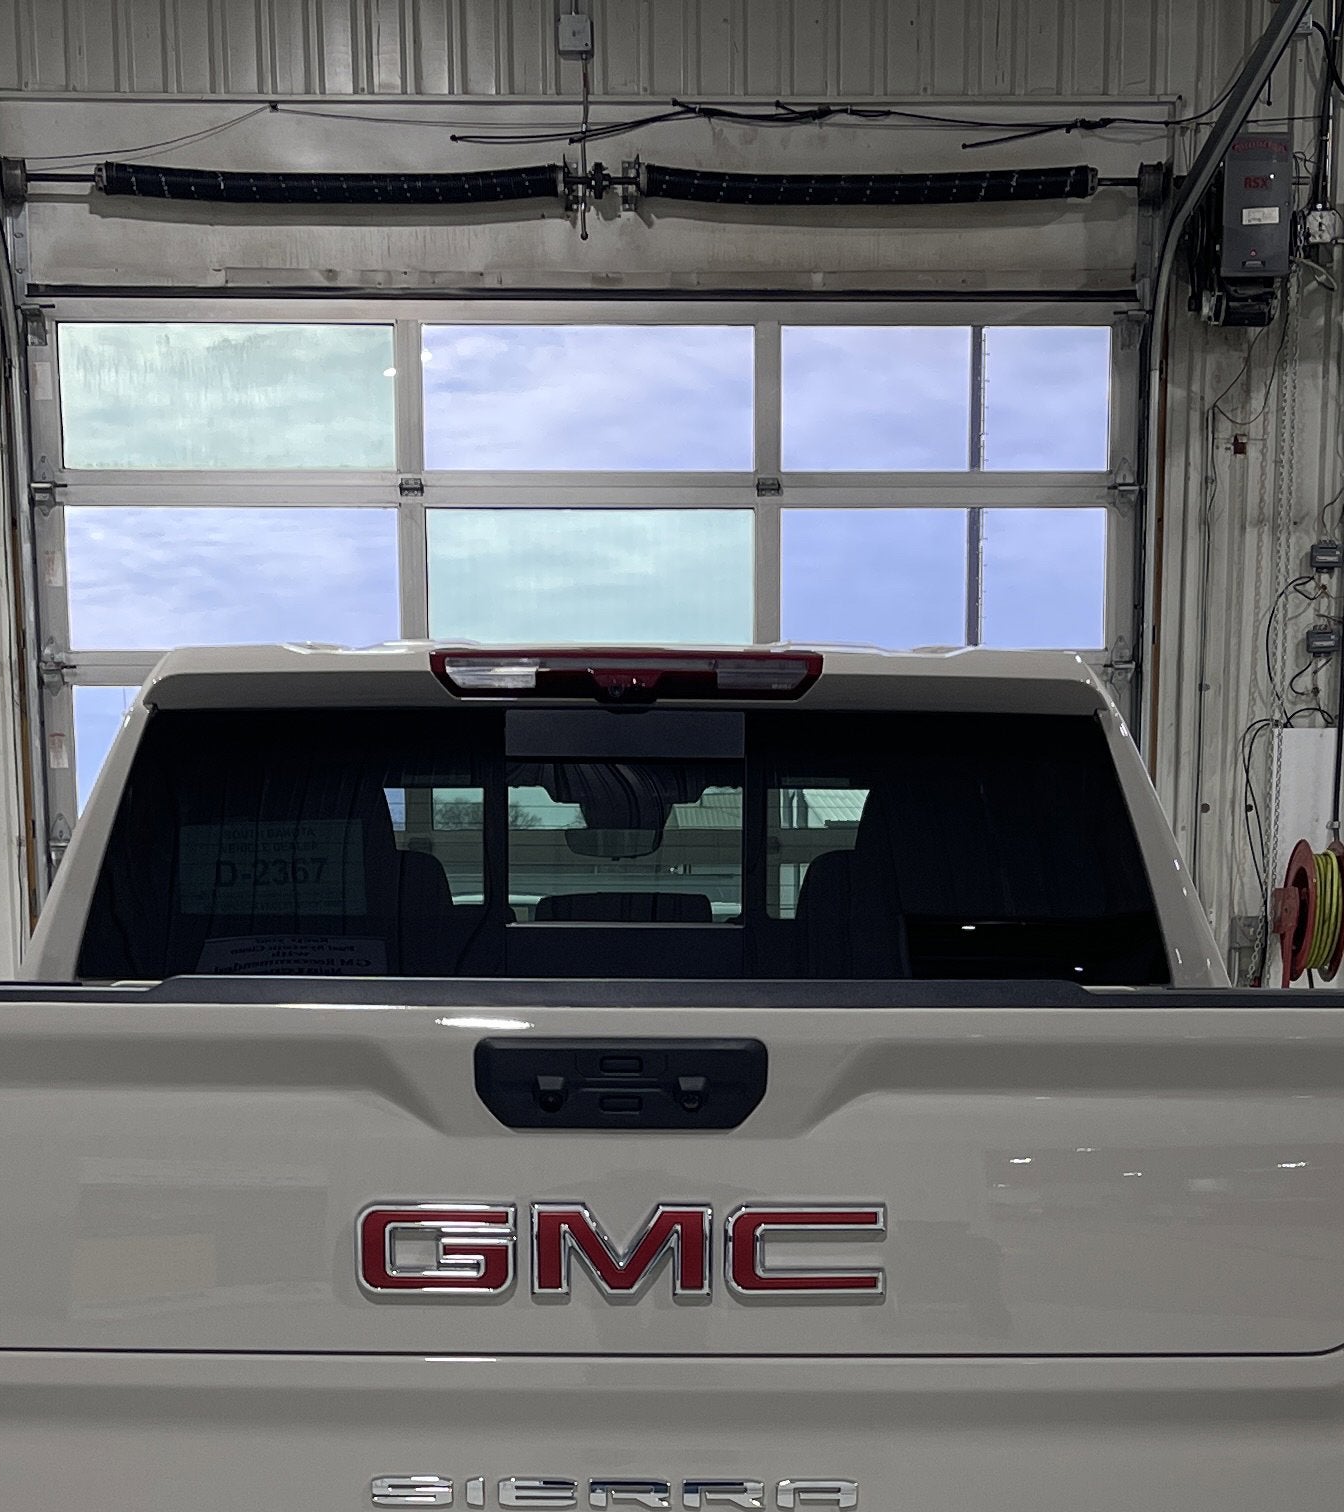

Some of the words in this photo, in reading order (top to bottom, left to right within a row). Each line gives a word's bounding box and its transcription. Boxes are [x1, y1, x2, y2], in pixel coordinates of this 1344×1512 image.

[215, 857, 328, 887] D-2367
[356, 1202, 887, 1297] GMC
[371, 1476, 858, 1510] SIERRA
